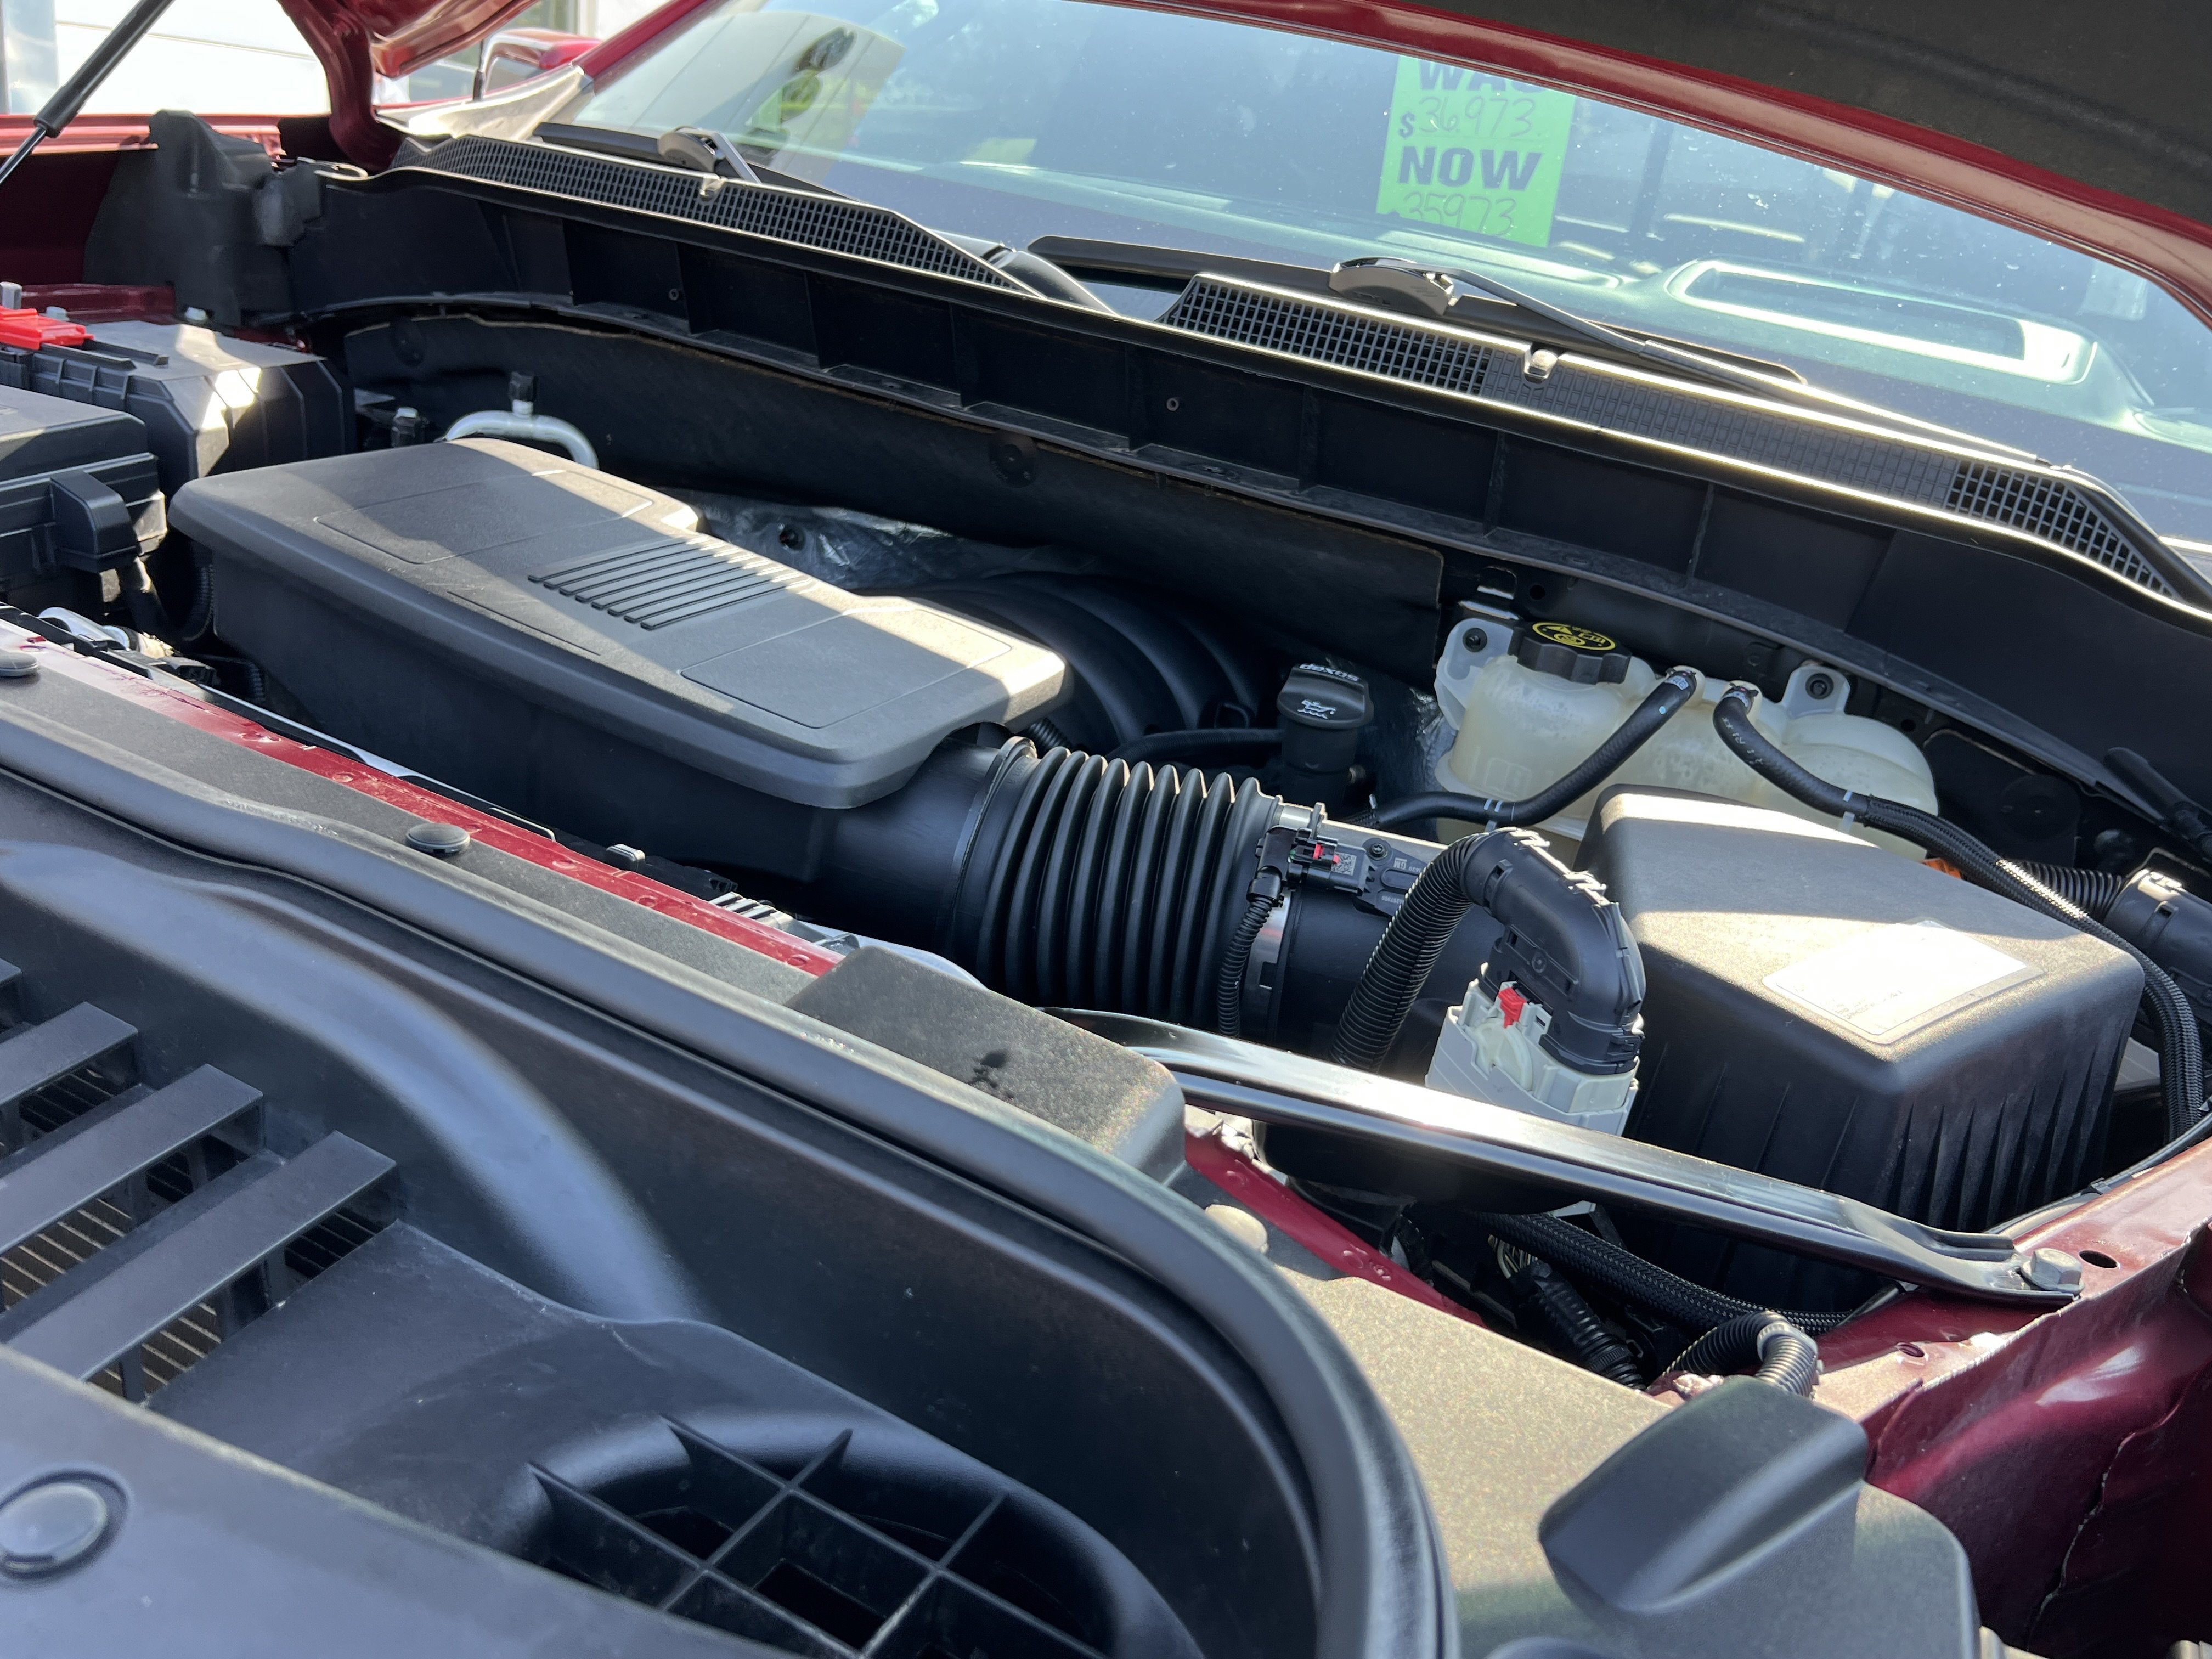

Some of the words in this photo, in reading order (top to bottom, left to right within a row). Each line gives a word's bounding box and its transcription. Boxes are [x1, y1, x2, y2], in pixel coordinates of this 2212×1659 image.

[1419, 59, 1546, 93] WA
[1397, 145, 1542, 191] NOW
[1299, 663, 1359, 681] dexos
[1393, 857, 1407, 870] GM
